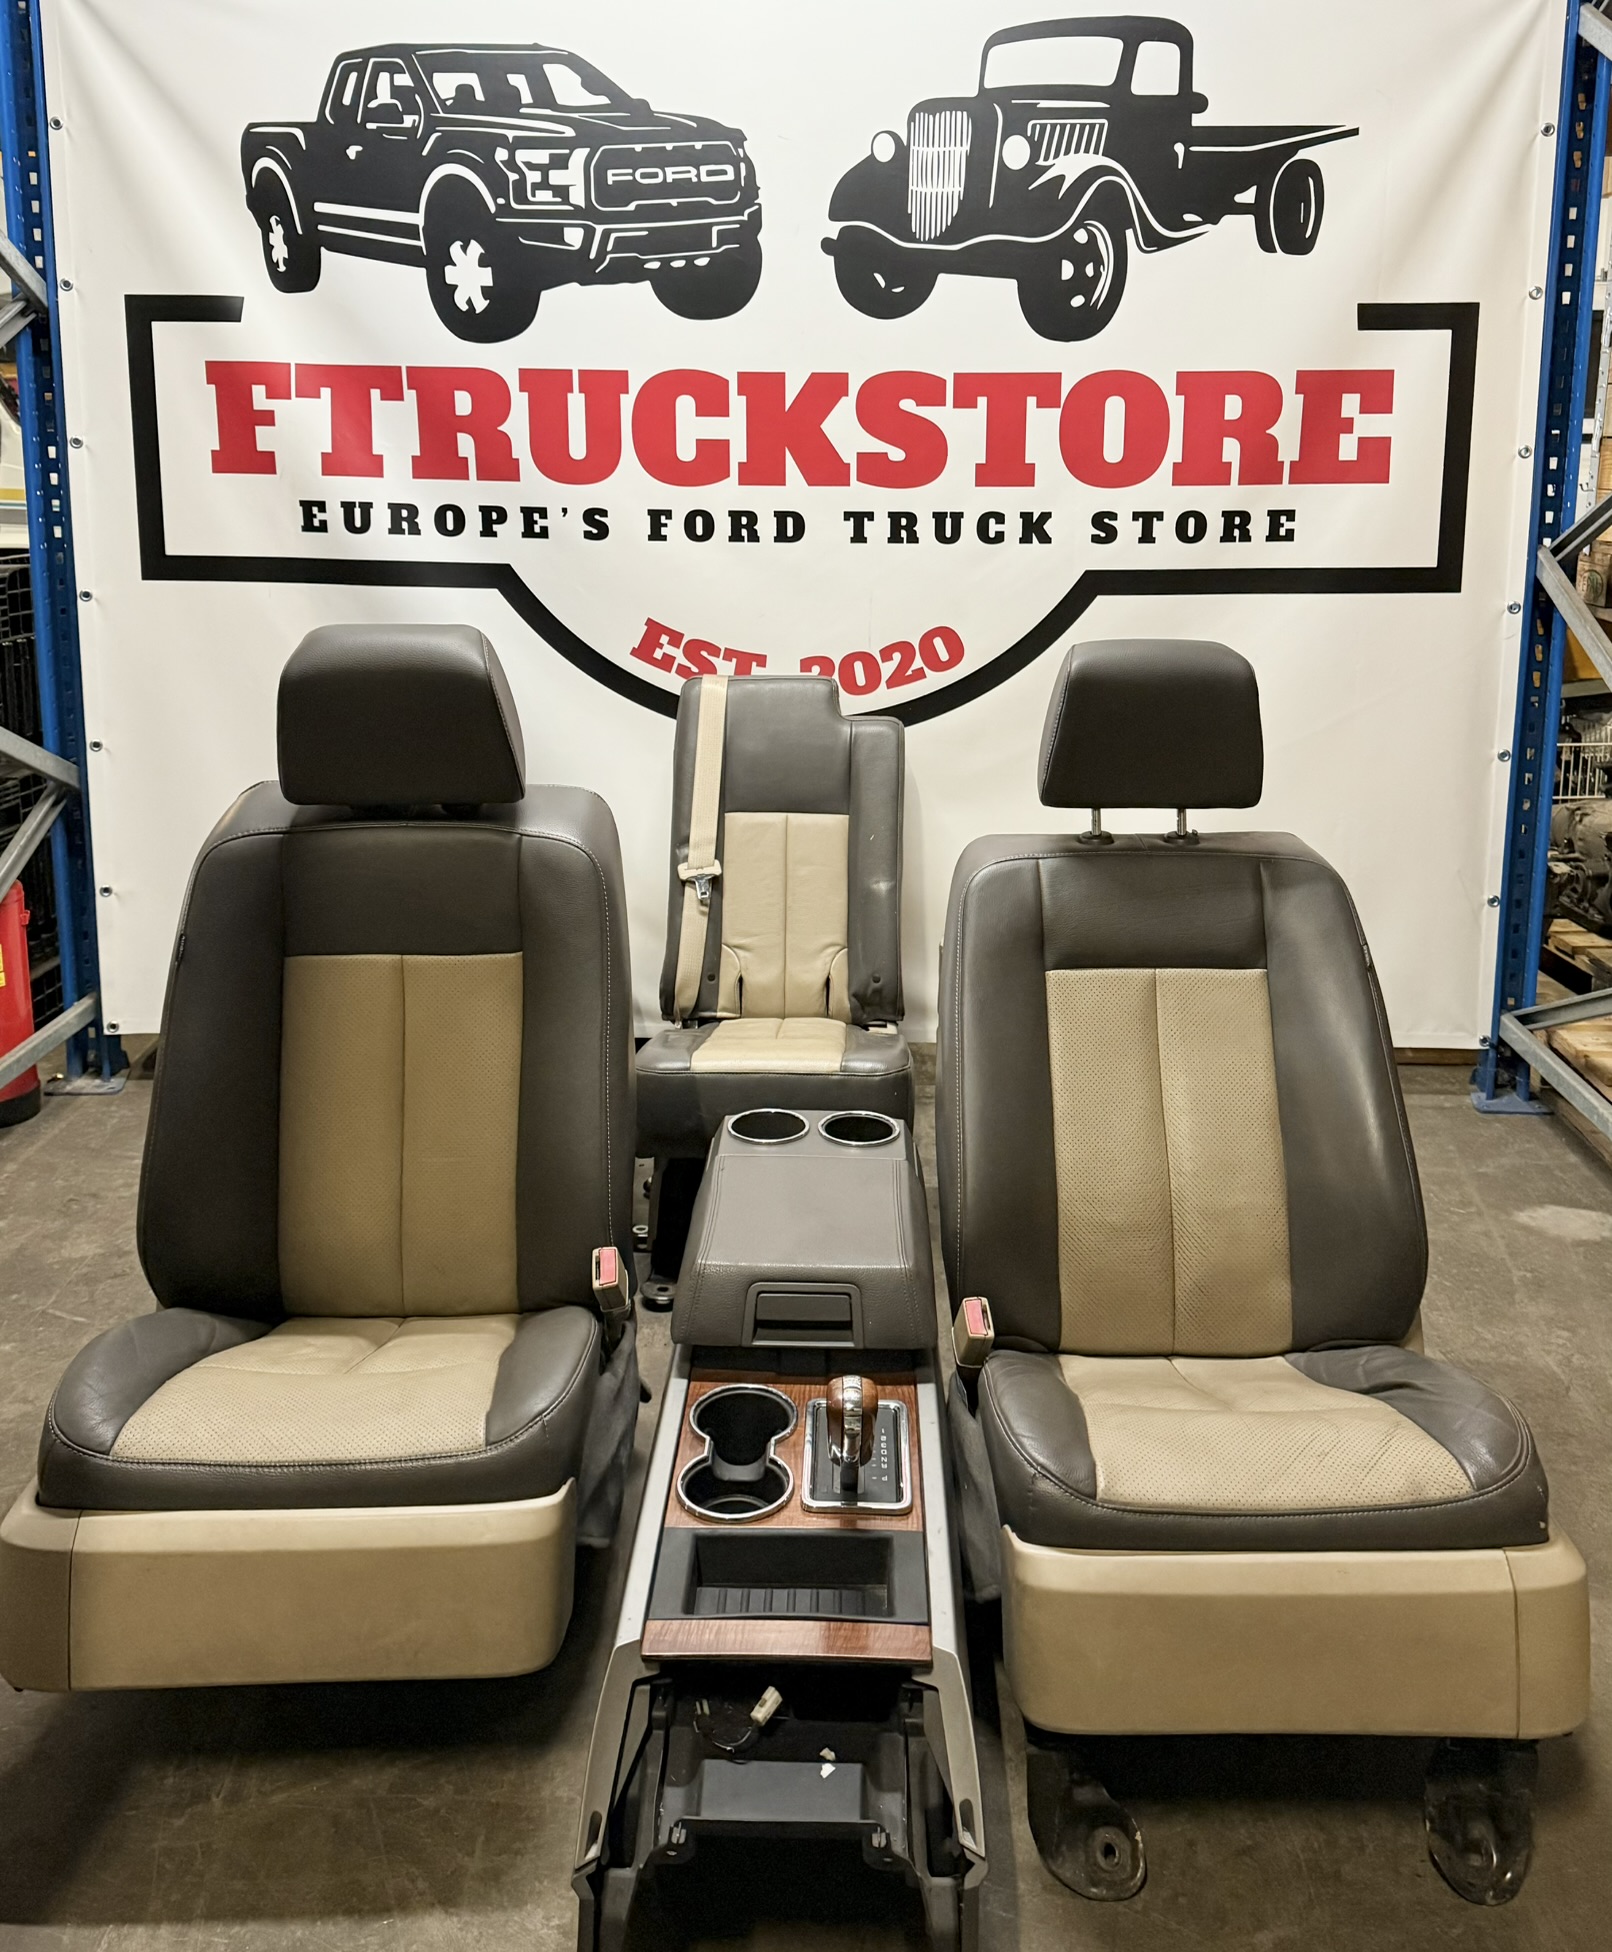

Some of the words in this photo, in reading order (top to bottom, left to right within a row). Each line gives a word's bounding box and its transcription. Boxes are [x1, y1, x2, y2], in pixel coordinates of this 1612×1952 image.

[607, 164, 735, 185] FORD
[206, 361, 1394, 488] FTRUCKSTORE
[299, 500, 609, 541] EUROPE'S
[648, 509, 805, 543] FORD
[844, 511, 1053, 545] TRUCK
[1091, 510, 1295, 544] STORE
